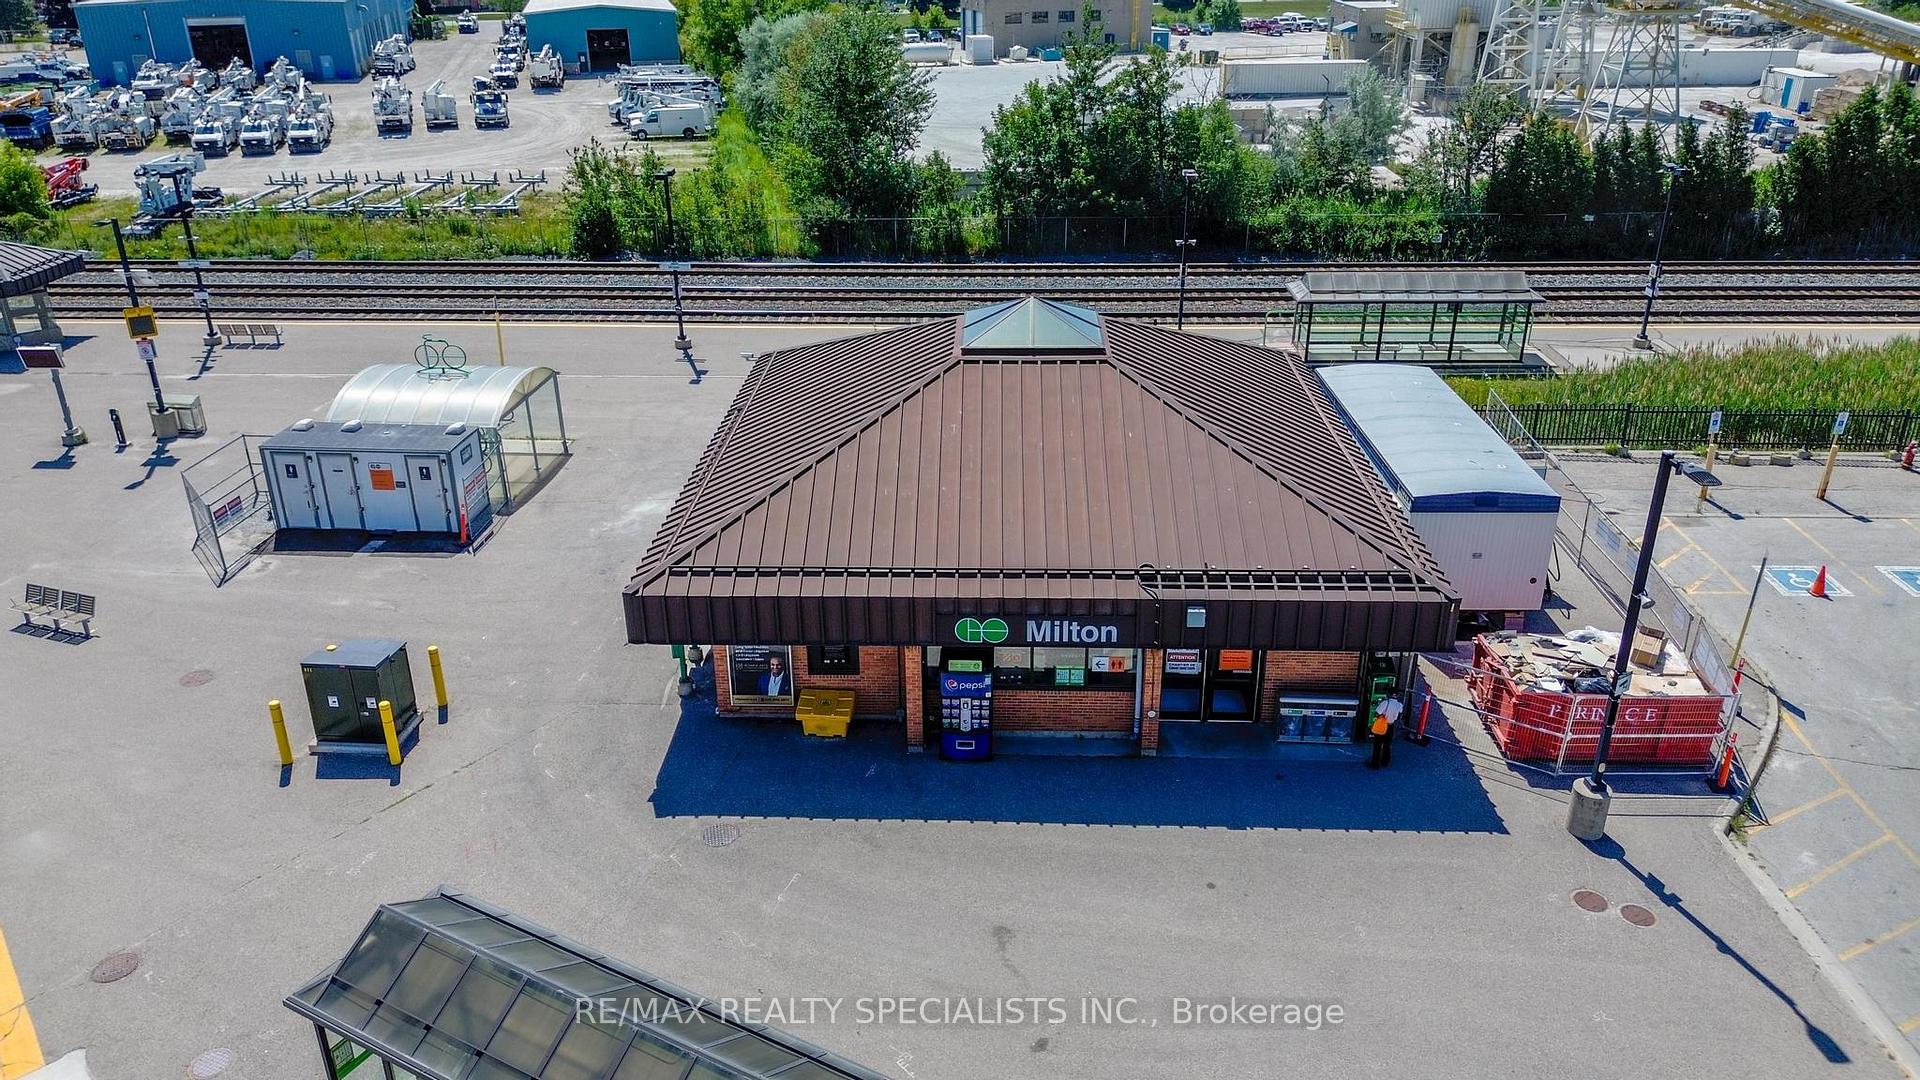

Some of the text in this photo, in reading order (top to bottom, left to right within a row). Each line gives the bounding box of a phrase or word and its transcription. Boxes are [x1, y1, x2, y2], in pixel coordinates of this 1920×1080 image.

[954, 617, 1118, 643] GO Milton
[959, 682, 986, 690] pepsi
[1548, 704, 1658, 721] PRINCE
